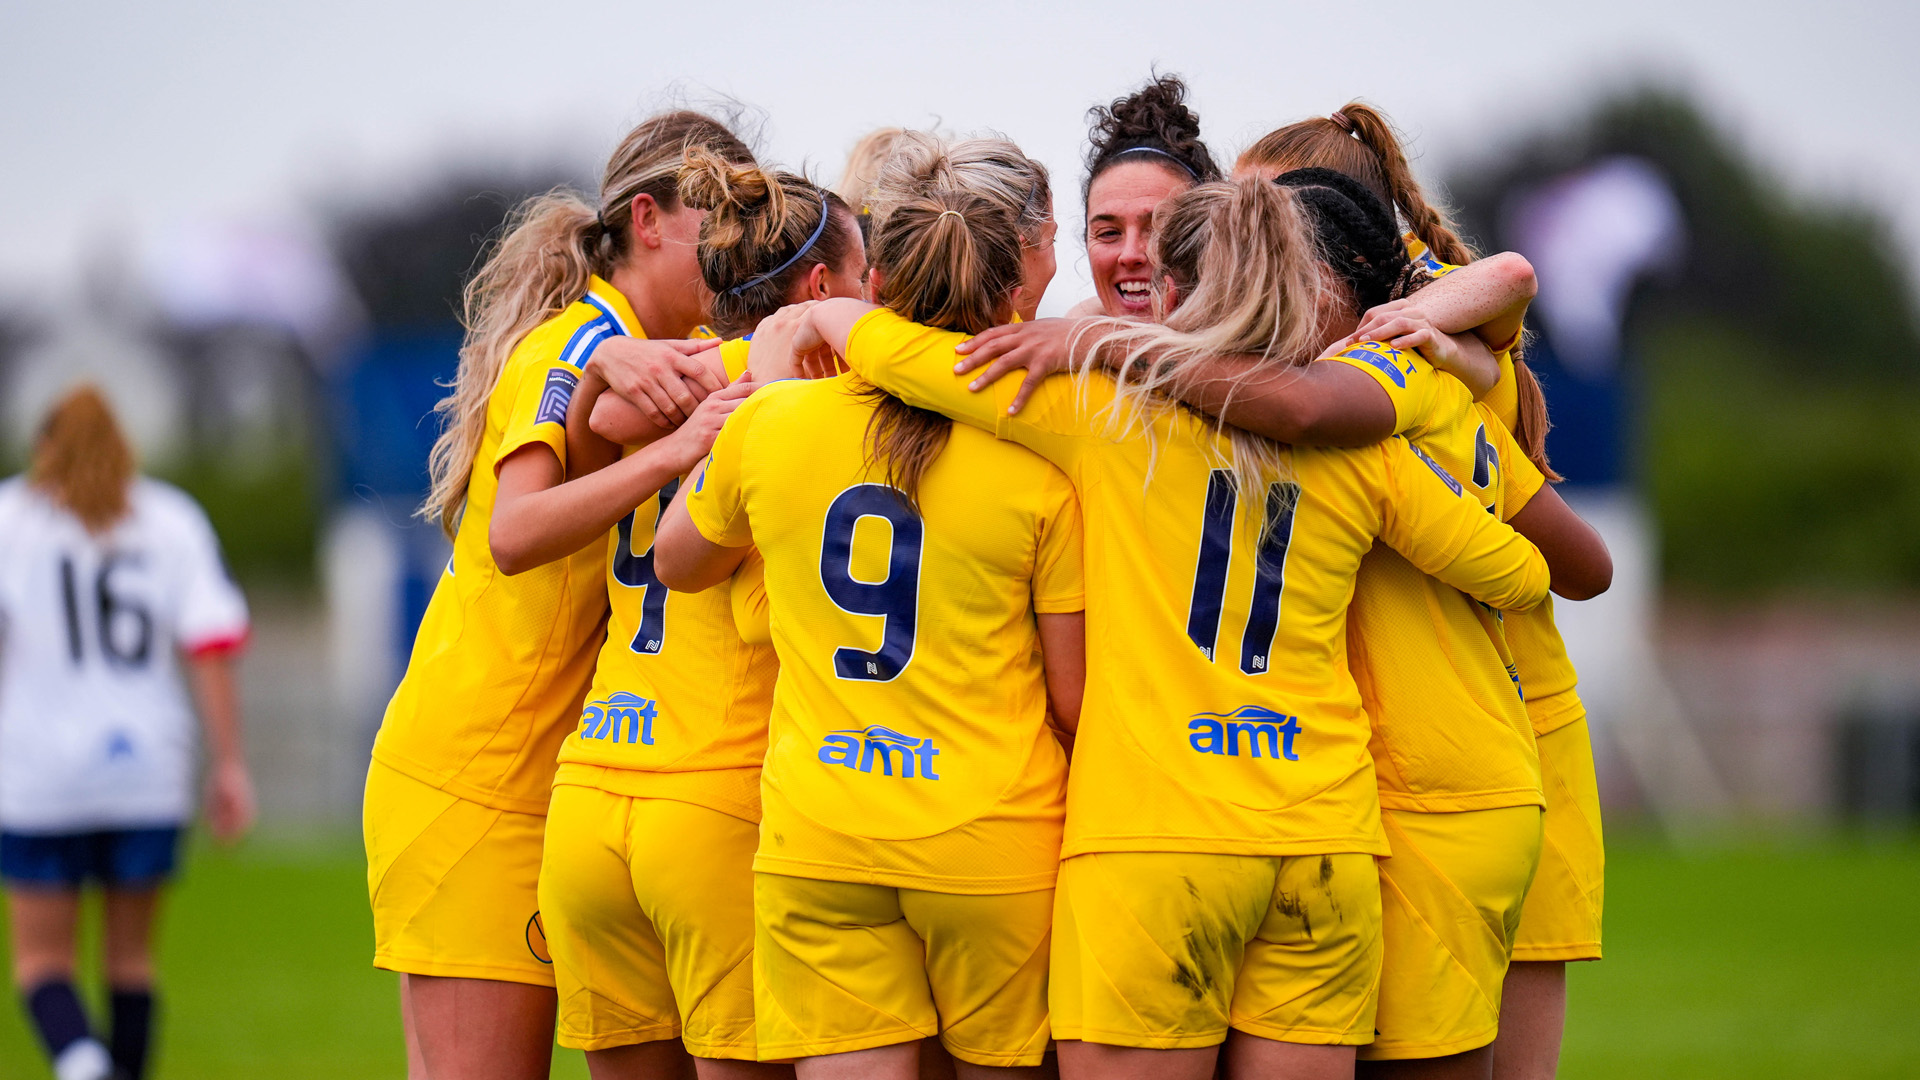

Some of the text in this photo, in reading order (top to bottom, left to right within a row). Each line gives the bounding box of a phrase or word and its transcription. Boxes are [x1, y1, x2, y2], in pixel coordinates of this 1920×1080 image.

[1343, 351, 1397, 377] LIFE
[612, 475, 680, 655] 4
[819, 482, 925, 682] 9
[1186, 467, 1301, 676] 11
[58, 549, 153, 672] 16
[580, 697, 658, 745] amt
[817, 733, 940, 781] amt
[1187, 713, 1302, 761] amt
